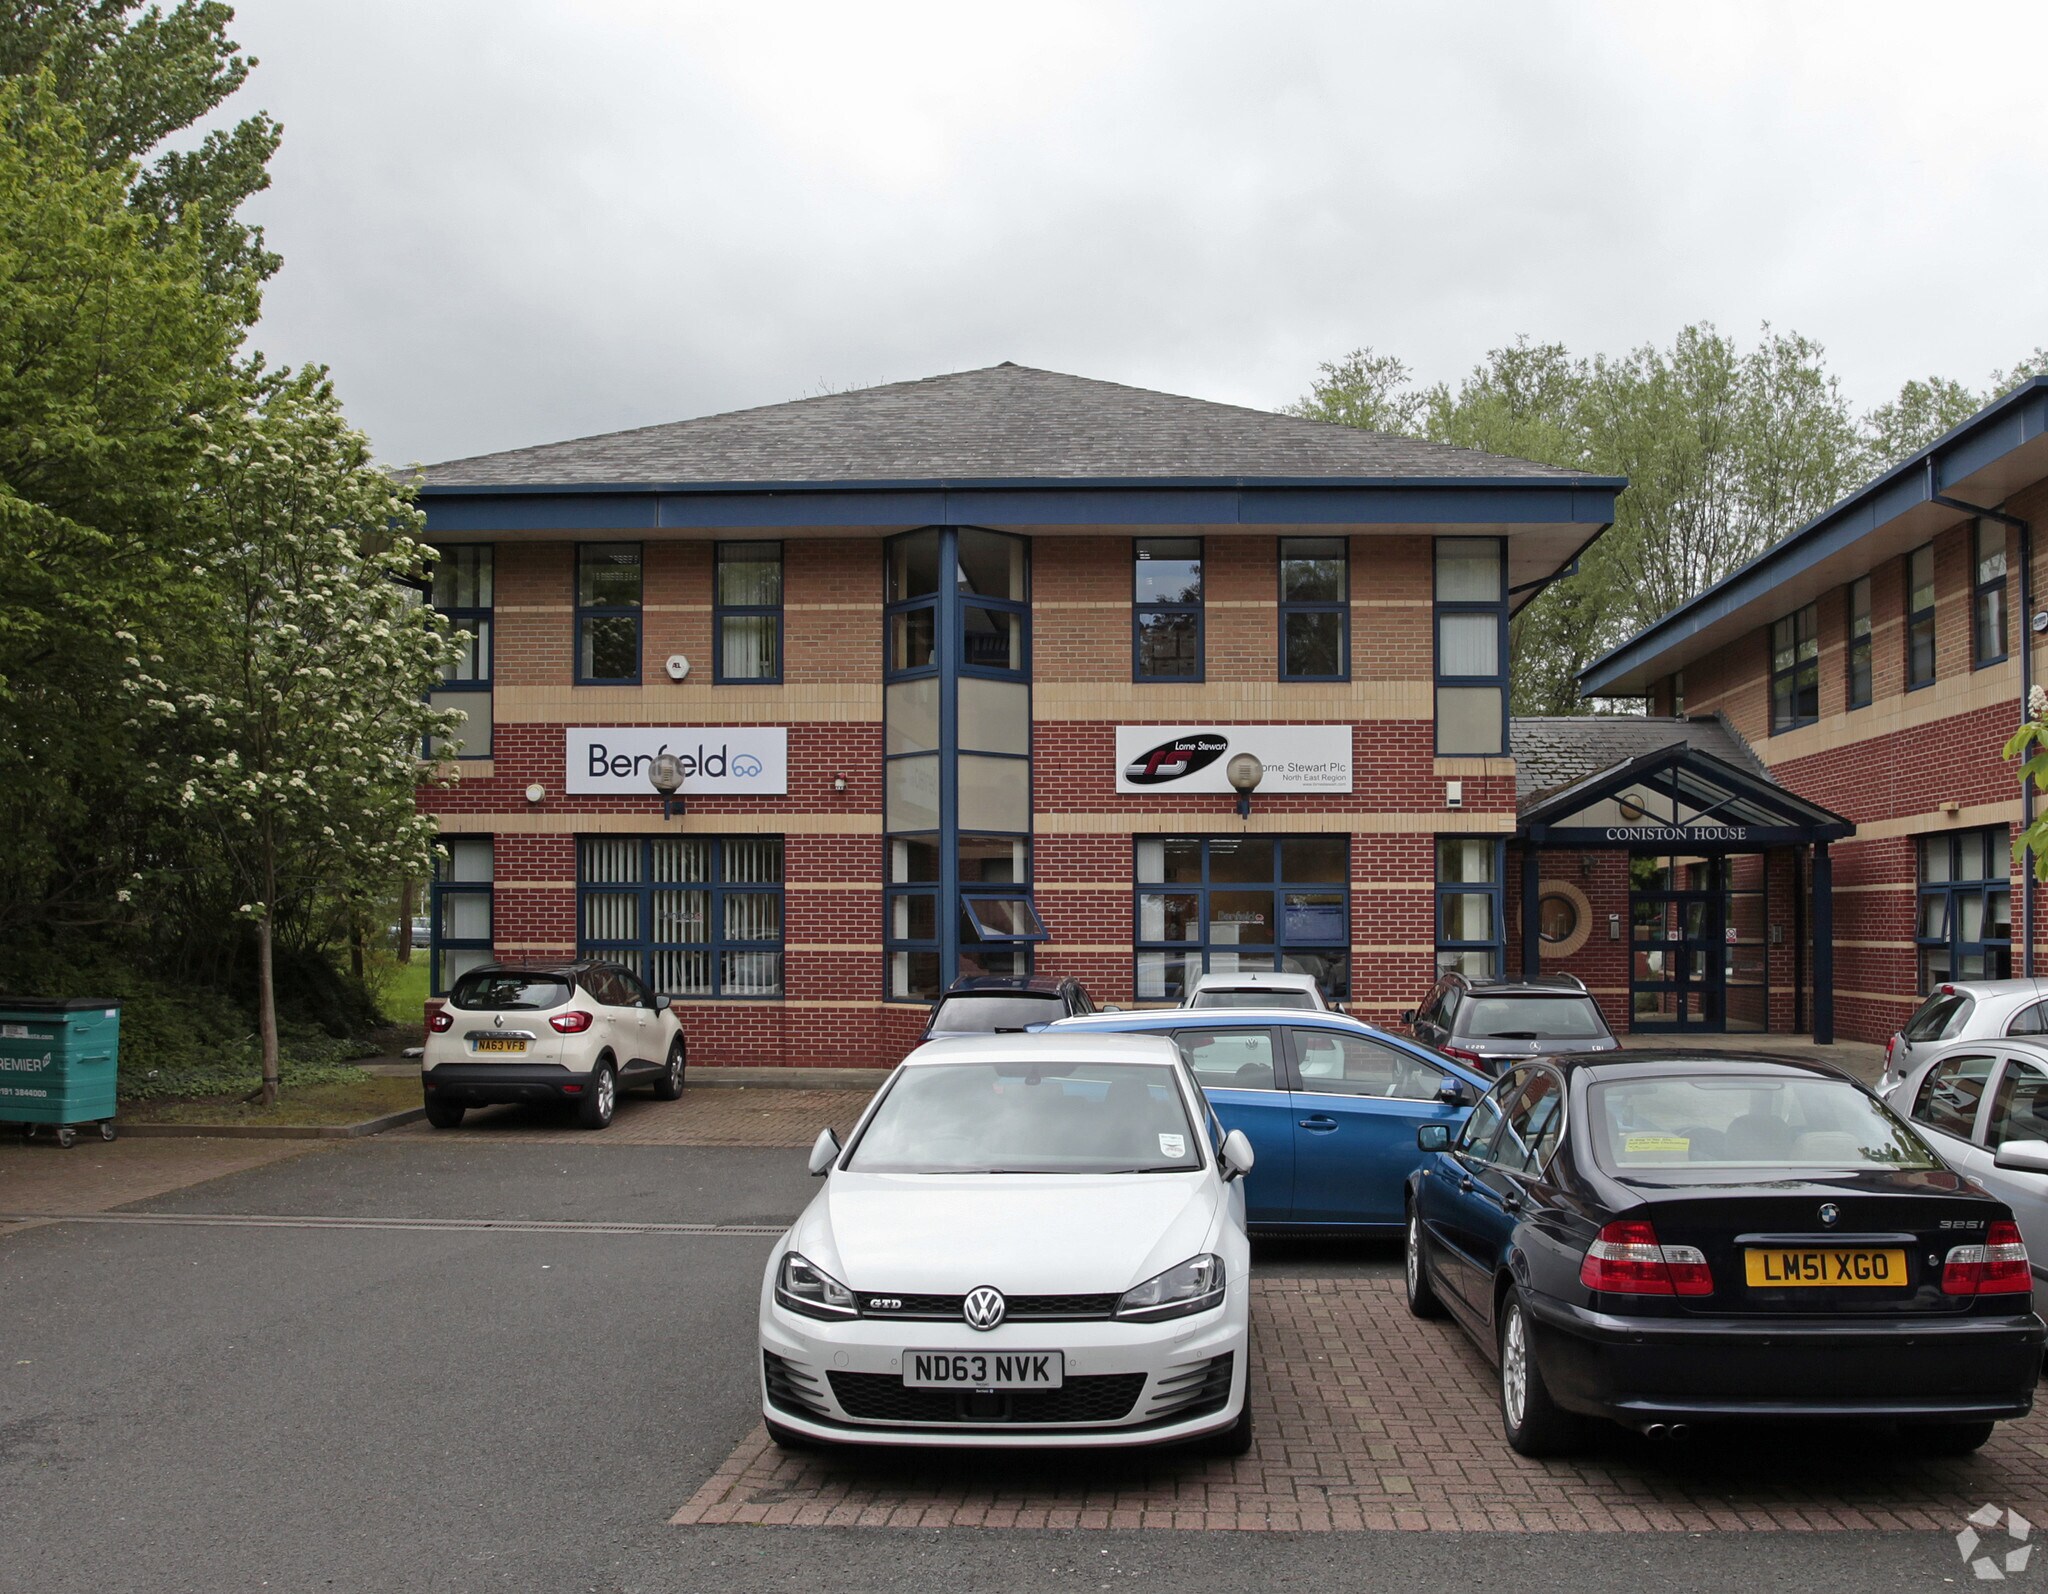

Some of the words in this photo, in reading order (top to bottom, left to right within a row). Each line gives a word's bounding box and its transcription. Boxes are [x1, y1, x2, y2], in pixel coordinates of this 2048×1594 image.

[1175, 741, 1196, 750] Lorne
[1198, 741, 1226, 750] Stewart
[589, 744, 727, 777] Benfeld
[1262, 763, 1284, 773] orne
[1287, 762, 1327, 772] Stewart
[1330, 762, 1346, 772] Plc
[1321, 774, 1347, 782] Region
[1606, 827, 1687, 840] CONISTON
[1694, 827, 1747, 840] HOUSE
[479, 1041, 504, 1051] NA63
[506, 1041, 526, 1051] VFB
[1763, 1253, 1828, 1281] LM51
[1834, 1253, 1889, 1280] XGO
[870, 1298, 902, 1309] GTD
[915, 1355, 987, 1382] ND63
[995, 1356, 1050, 1382] NVK
